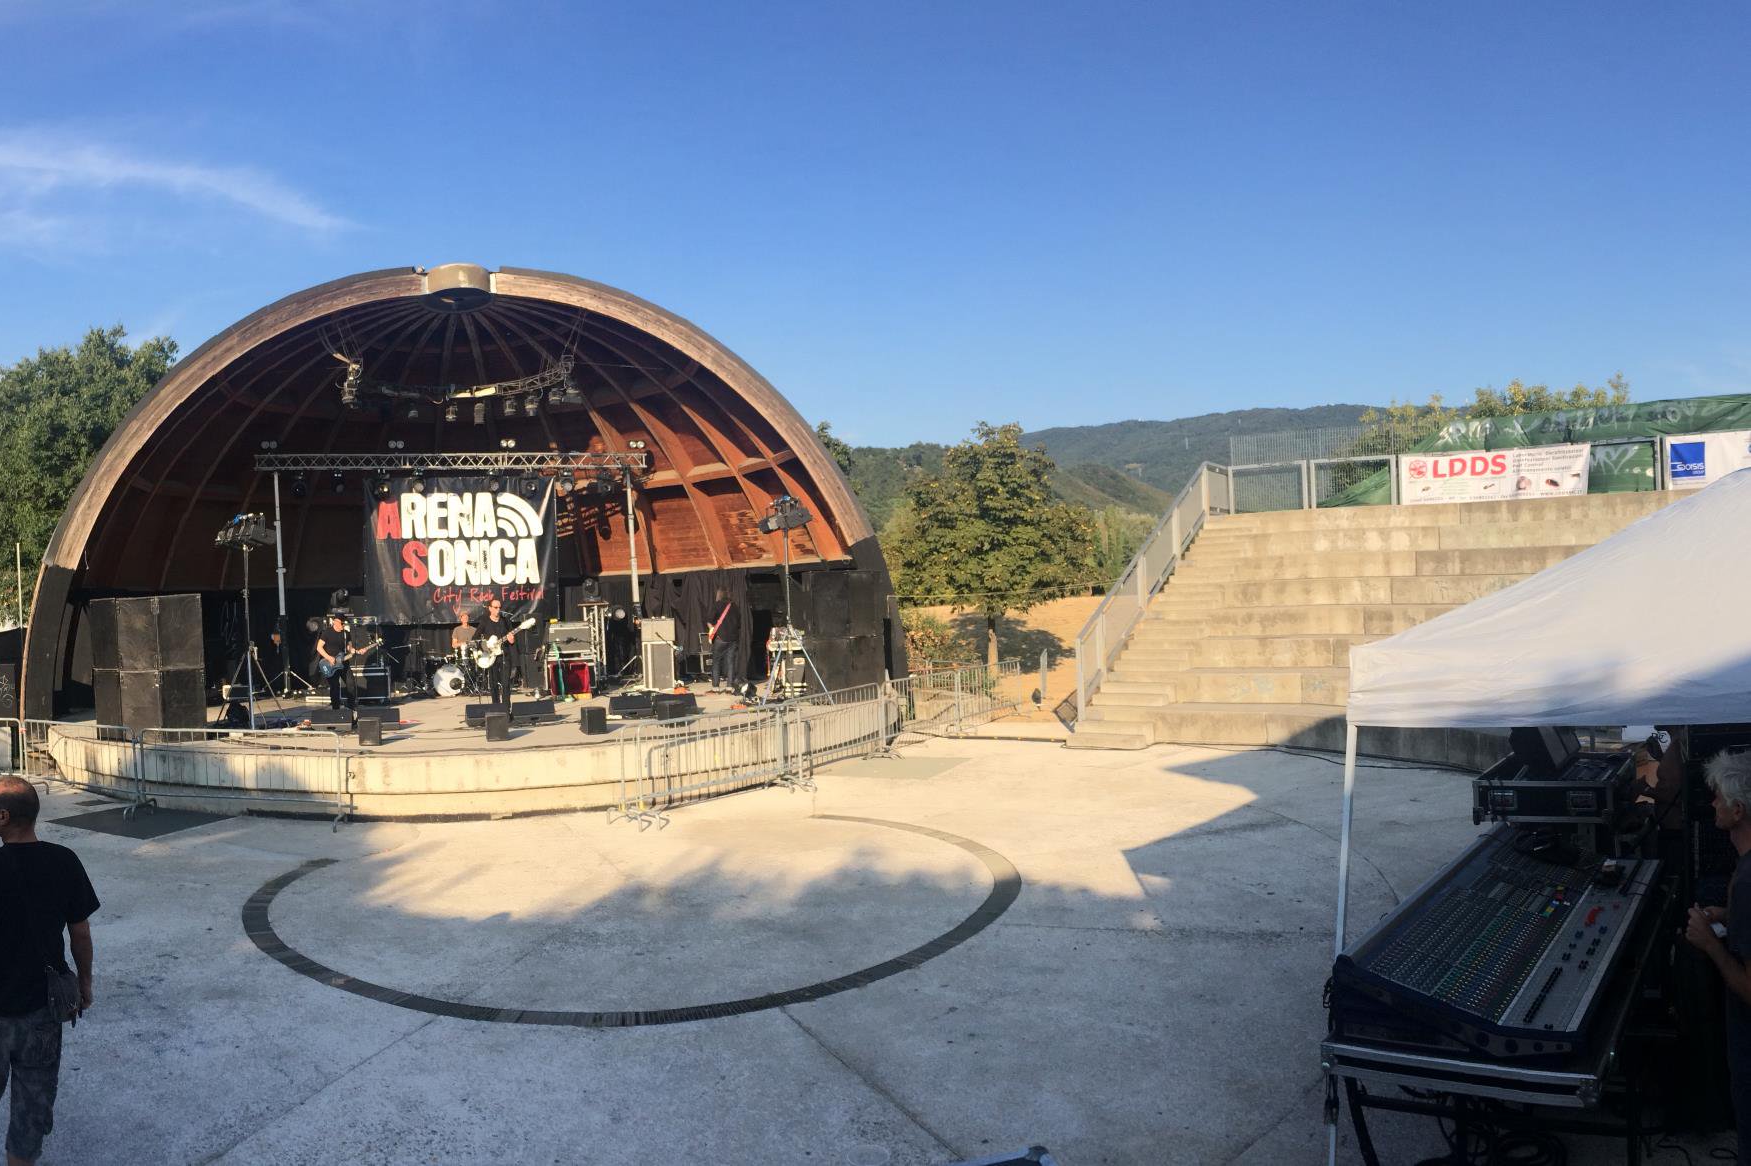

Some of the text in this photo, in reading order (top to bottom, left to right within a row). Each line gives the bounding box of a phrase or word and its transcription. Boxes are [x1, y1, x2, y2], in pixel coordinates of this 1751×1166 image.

[1432, 454, 1507, 479] LDDS
[376, 492, 498, 539] ARENA
[402, 538, 541, 587] SONICA
[433, 585, 463, 614] City
[501, 584, 544, 602] Festival
